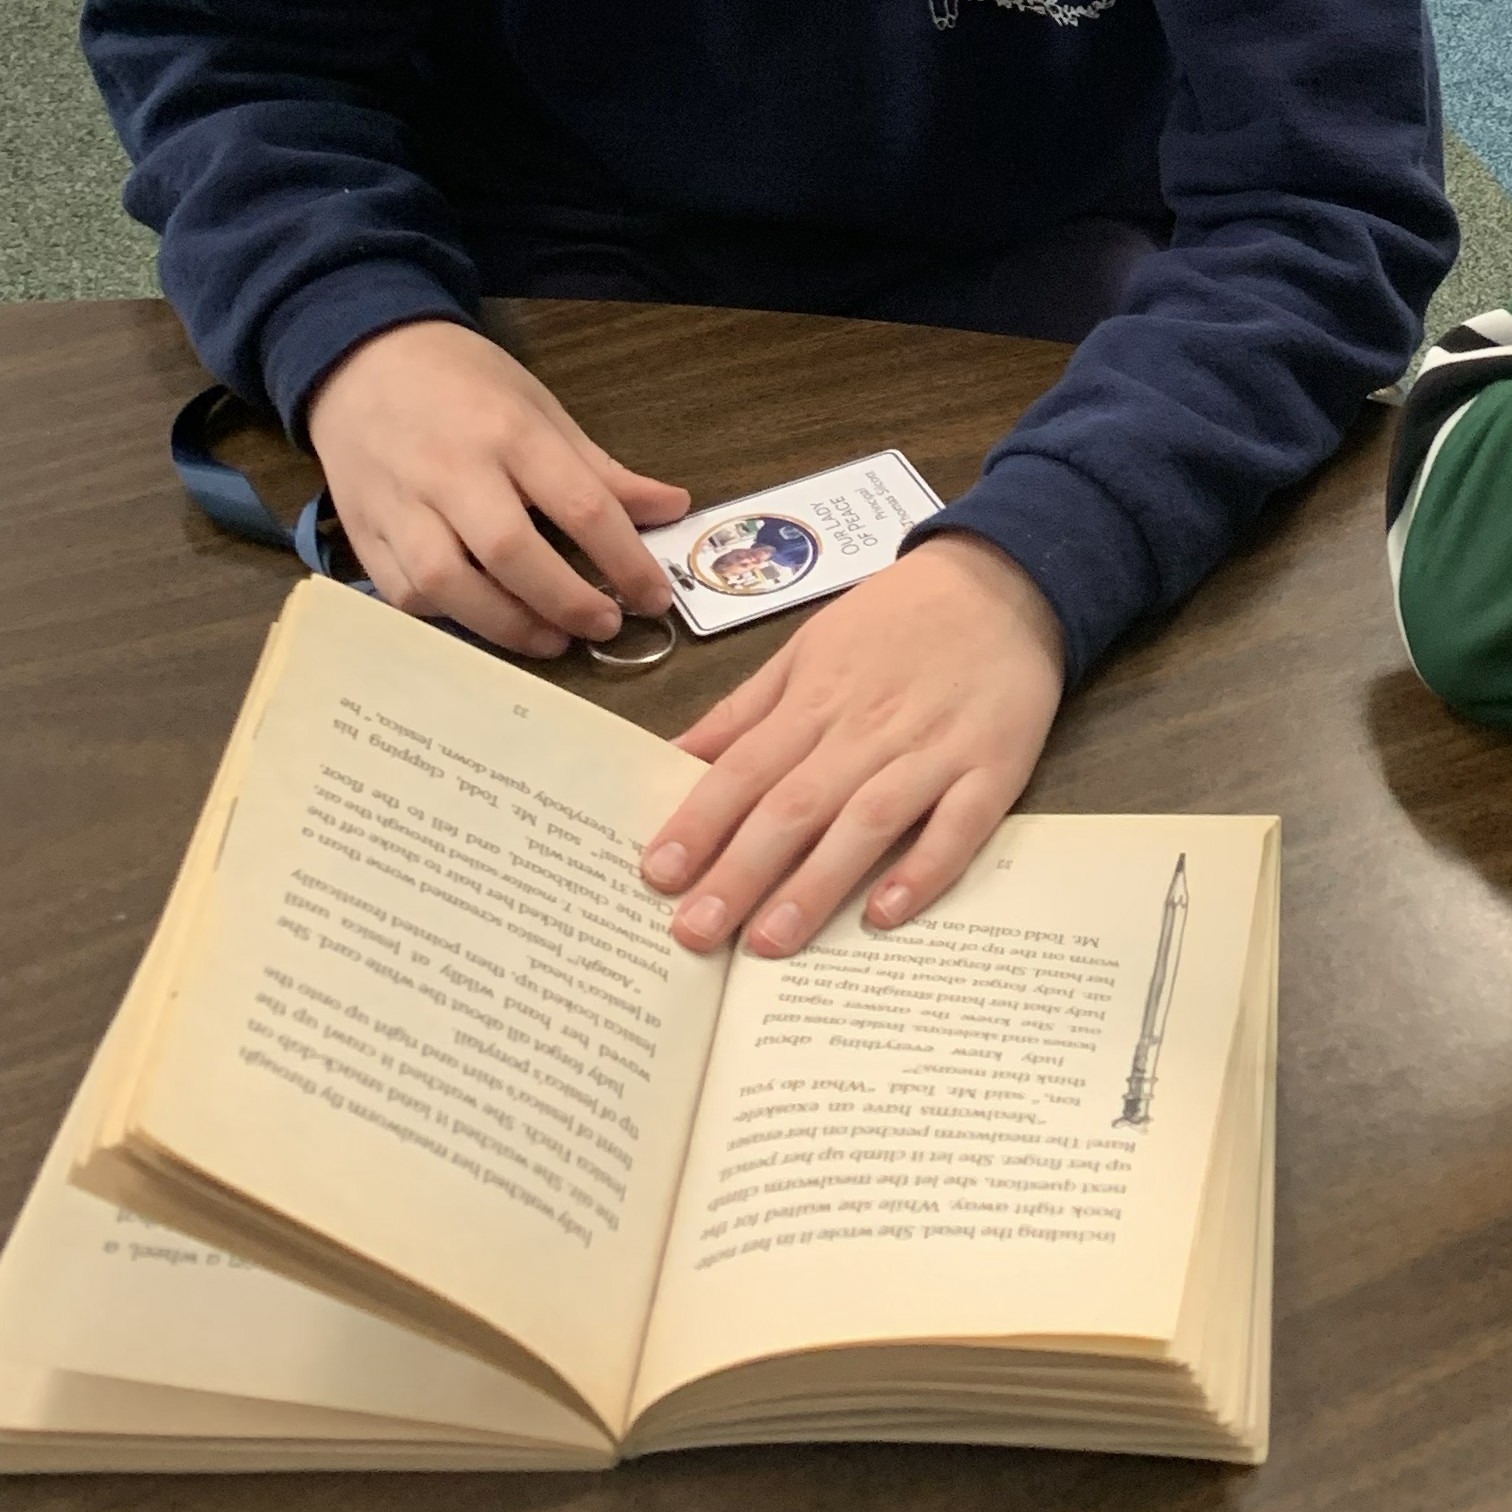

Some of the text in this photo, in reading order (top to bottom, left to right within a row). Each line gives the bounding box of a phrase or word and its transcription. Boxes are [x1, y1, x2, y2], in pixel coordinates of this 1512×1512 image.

[829, 495, 867, 533] PEACE
[854, 487, 888, 521] Principal
[810, 502, 860, 555] OUR LADY
[339, 696, 362, 717] he
[332, 717, 359, 741] his
[367, 731, 445, 778] clapping
[488, 768, 531, 795] quiet
[343, 798, 373, 822] the
[370, 788, 400, 812] the
[406, 805, 425, 823] to
[301, 825, 315, 838] a
[373, 813, 446, 856] through
[430, 816, 459, 839] fell
[545, 821, 581, 846] said
[317, 832, 362, 864] than
[464, 832, 500, 855] and
[364, 854, 416, 886] worse
[446, 847, 499, 877] sailed
[565, 856, 606, 882] went
[291, 864, 388, 925] frantically
[306, 804, 669, 983] hyena and flicked her hair to shake off the
[499, 871, 557, 904] molitor
[609, 877, 629, 897] 3T
[417, 880, 503, 926] screamed
[615, 902, 642, 926] the
[631, 888, 673, 919] Class
[276, 914, 311, 943] She
[388, 914, 461, 955] pointed
[941, 921, 965, 930] on
[966, 924, 1021, 937] called
[1022, 930, 1064, 945] Todd
[505, 921, 563, 959] Jessica
[364, 955, 415, 988] white
[464, 949, 506, 981] then
[282, 890, 651, 1082] waved her hand wildly at Jessica until
[417, 981, 447, 1009] the
[254, 990, 288, 1020] the
[291, 1004, 319, 1030] up
[448, 997, 504, 1032] about
[539, 985, 600, 1028] looked
[643, 1011, 661, 1028] at
[321, 1023, 377, 1058] crawl
[505, 1024, 530, 1045] all
[602, 1017, 656, 1059] Jessica
[378, 1051, 395, 1072] it
[531, 1037, 584, 1078] forgot
[396, 1059, 478, 1109] watched
[587, 1062, 624, 1101] Judy
[739, 1079, 775, 1094] you
[779, 1080, 806, 1092] do
[989, 1069, 1031, 1083] that
[1033, 1074, 1086, 1089] think
[826, 1102, 855, 1110] an
[982, 1089, 1025, 1101] said
[481, 1101, 515, 1134] She
[598, 1103, 617, 1123] of
[861, 1103, 912, 1117] have
[618, 1111, 639, 1143] tip
[575, 1153, 627, 1202] Jessica
[761, 1201, 832, 1226] waited
[836, 1200, 873, 1215] she
[877, 1199, 941, 1214] While
[1013, 1200, 1065, 1217] right
[1069, 1205, 1122, 1220] book
[700, 1220, 729, 1240] the
[732, 1212, 759, 1228] for
[876, 1225, 914, 1239] She
[774, 1233, 796, 1249] in
[815, 1226, 875, 1243] wrote
[979, 1226, 1014, 1241] the
[1016, 1224, 1116, 1244] including
[739, 1237, 772, 1255] her
